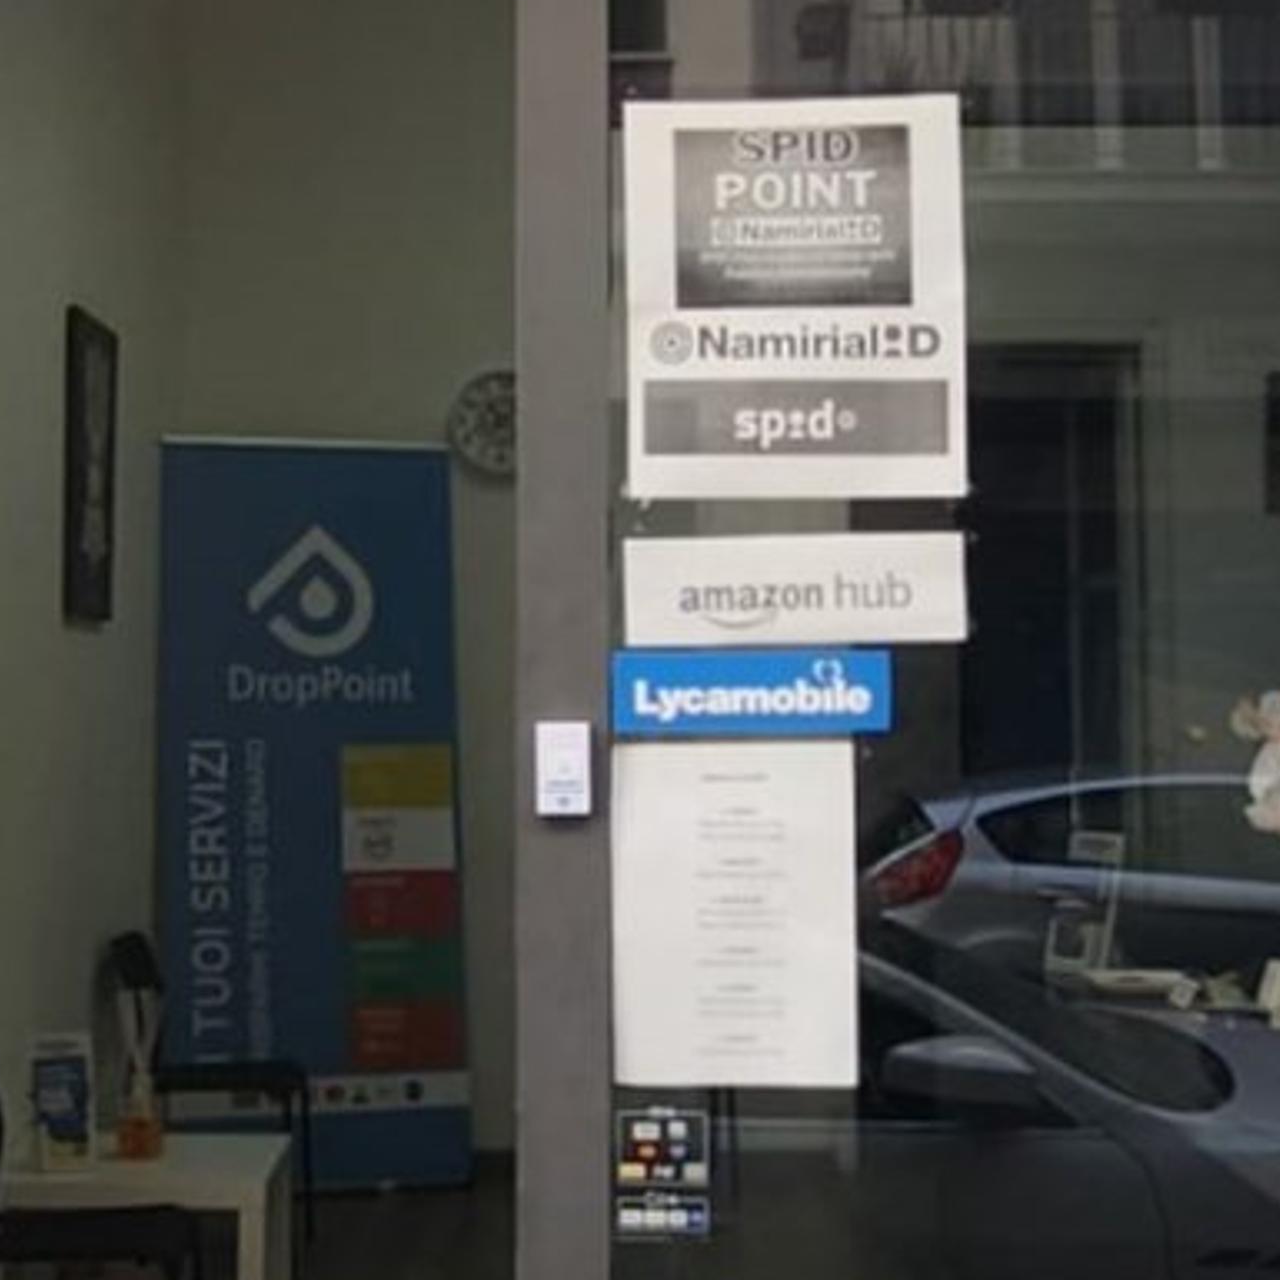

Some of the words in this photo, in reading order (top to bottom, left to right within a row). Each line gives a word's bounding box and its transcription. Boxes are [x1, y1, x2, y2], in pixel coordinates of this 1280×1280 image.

[738, 129, 855, 163] SPID
[714, 170, 878, 209] POINT
[733, 399, 836, 451] spid
[679, 582, 825, 615] amazon
[833, 571, 914, 610] hub
[226, 663, 415, 708] DropPoint
[631, 675, 873, 723] Lycamobile
[187, 739, 231, 912] SERVIZI
[191, 927, 234, 1038] TUOI
